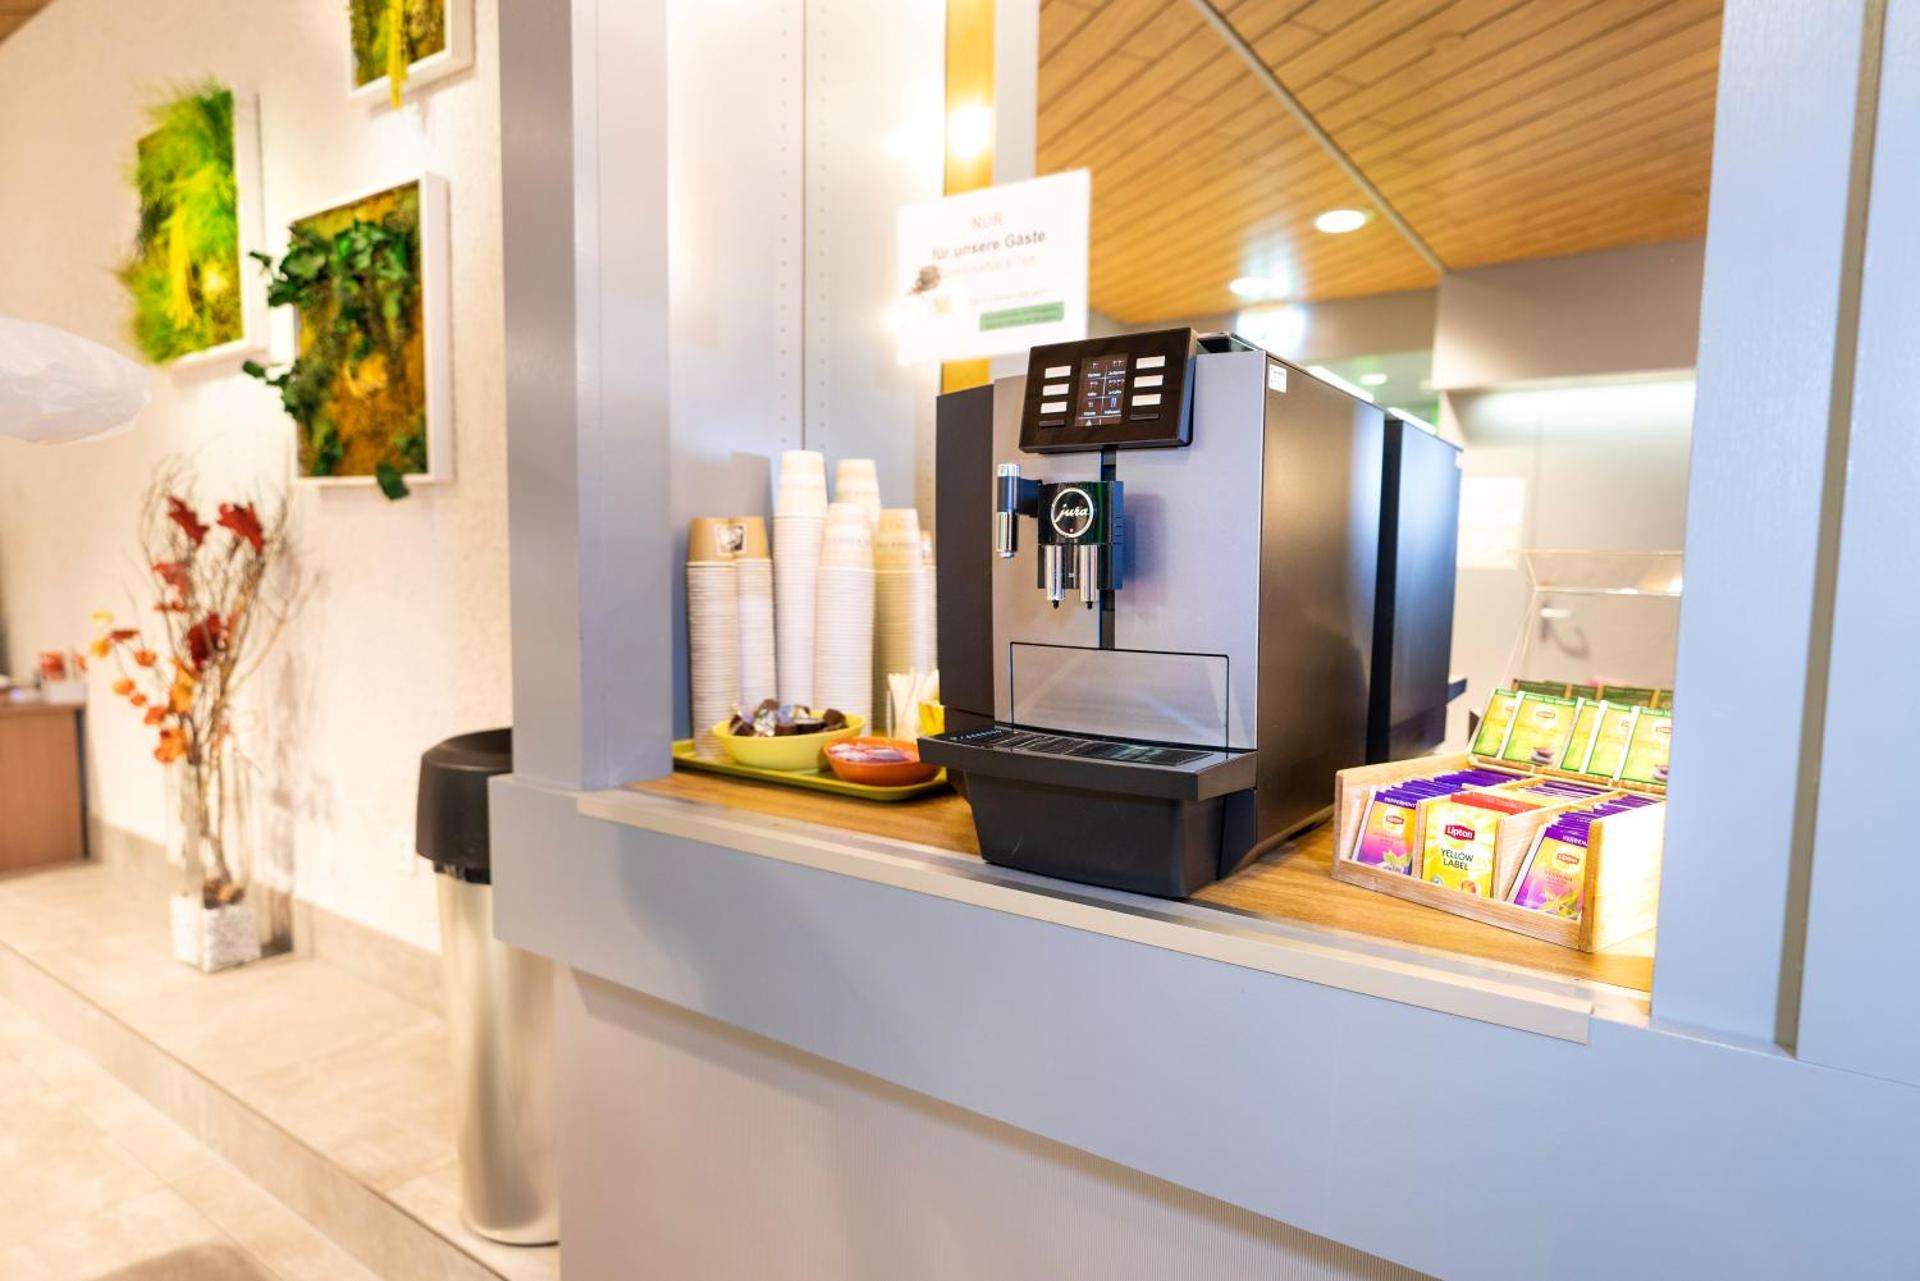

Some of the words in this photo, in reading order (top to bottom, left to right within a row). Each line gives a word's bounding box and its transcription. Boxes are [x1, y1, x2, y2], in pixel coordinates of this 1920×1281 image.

[971, 212, 1004, 229] NUR
[954, 240, 1000, 257] unsere
[1004, 230, 1047, 249] Gäste
[1053, 503, 1089, 523] jura
[1446, 826, 1473, 839] Lipton
[1441, 848, 1474, 862] YELLOW
[1443, 858, 1468, 871] LABEL
